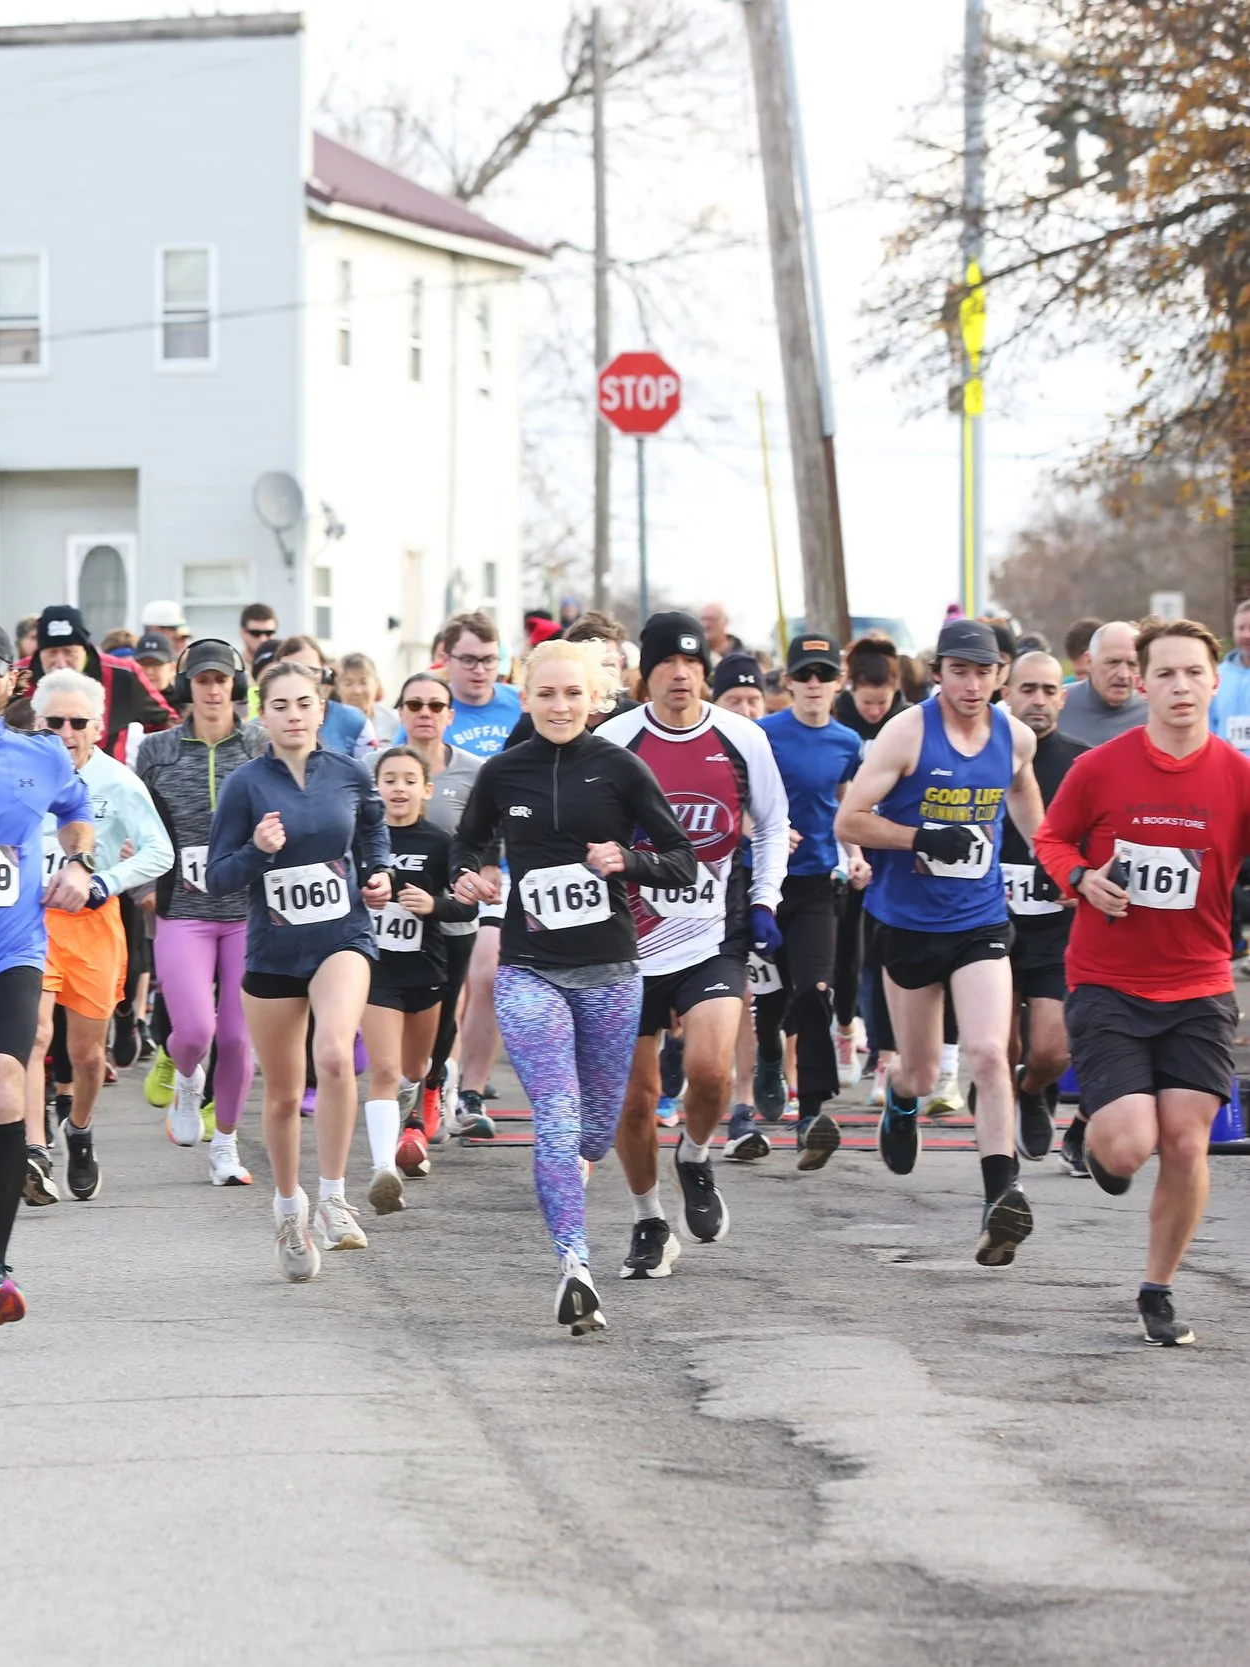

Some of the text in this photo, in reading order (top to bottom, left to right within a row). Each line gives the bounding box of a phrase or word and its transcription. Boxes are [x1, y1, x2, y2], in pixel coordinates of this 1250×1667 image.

[601, 374, 678, 411] STOP
[453, 726, 510, 745] BUFFAL
[925, 787, 971, 805] GOOD
[1132, 816, 1206, 830] A BOOKSTORE
[1119, 860, 1190, 894] 1161
[273, 878, 340, 911] 1060
[528, 880, 600, 915] 1163
[651, 880, 714, 903] 1054
[373, 914, 417, 940] 140
[750, 964, 772, 984] 91
